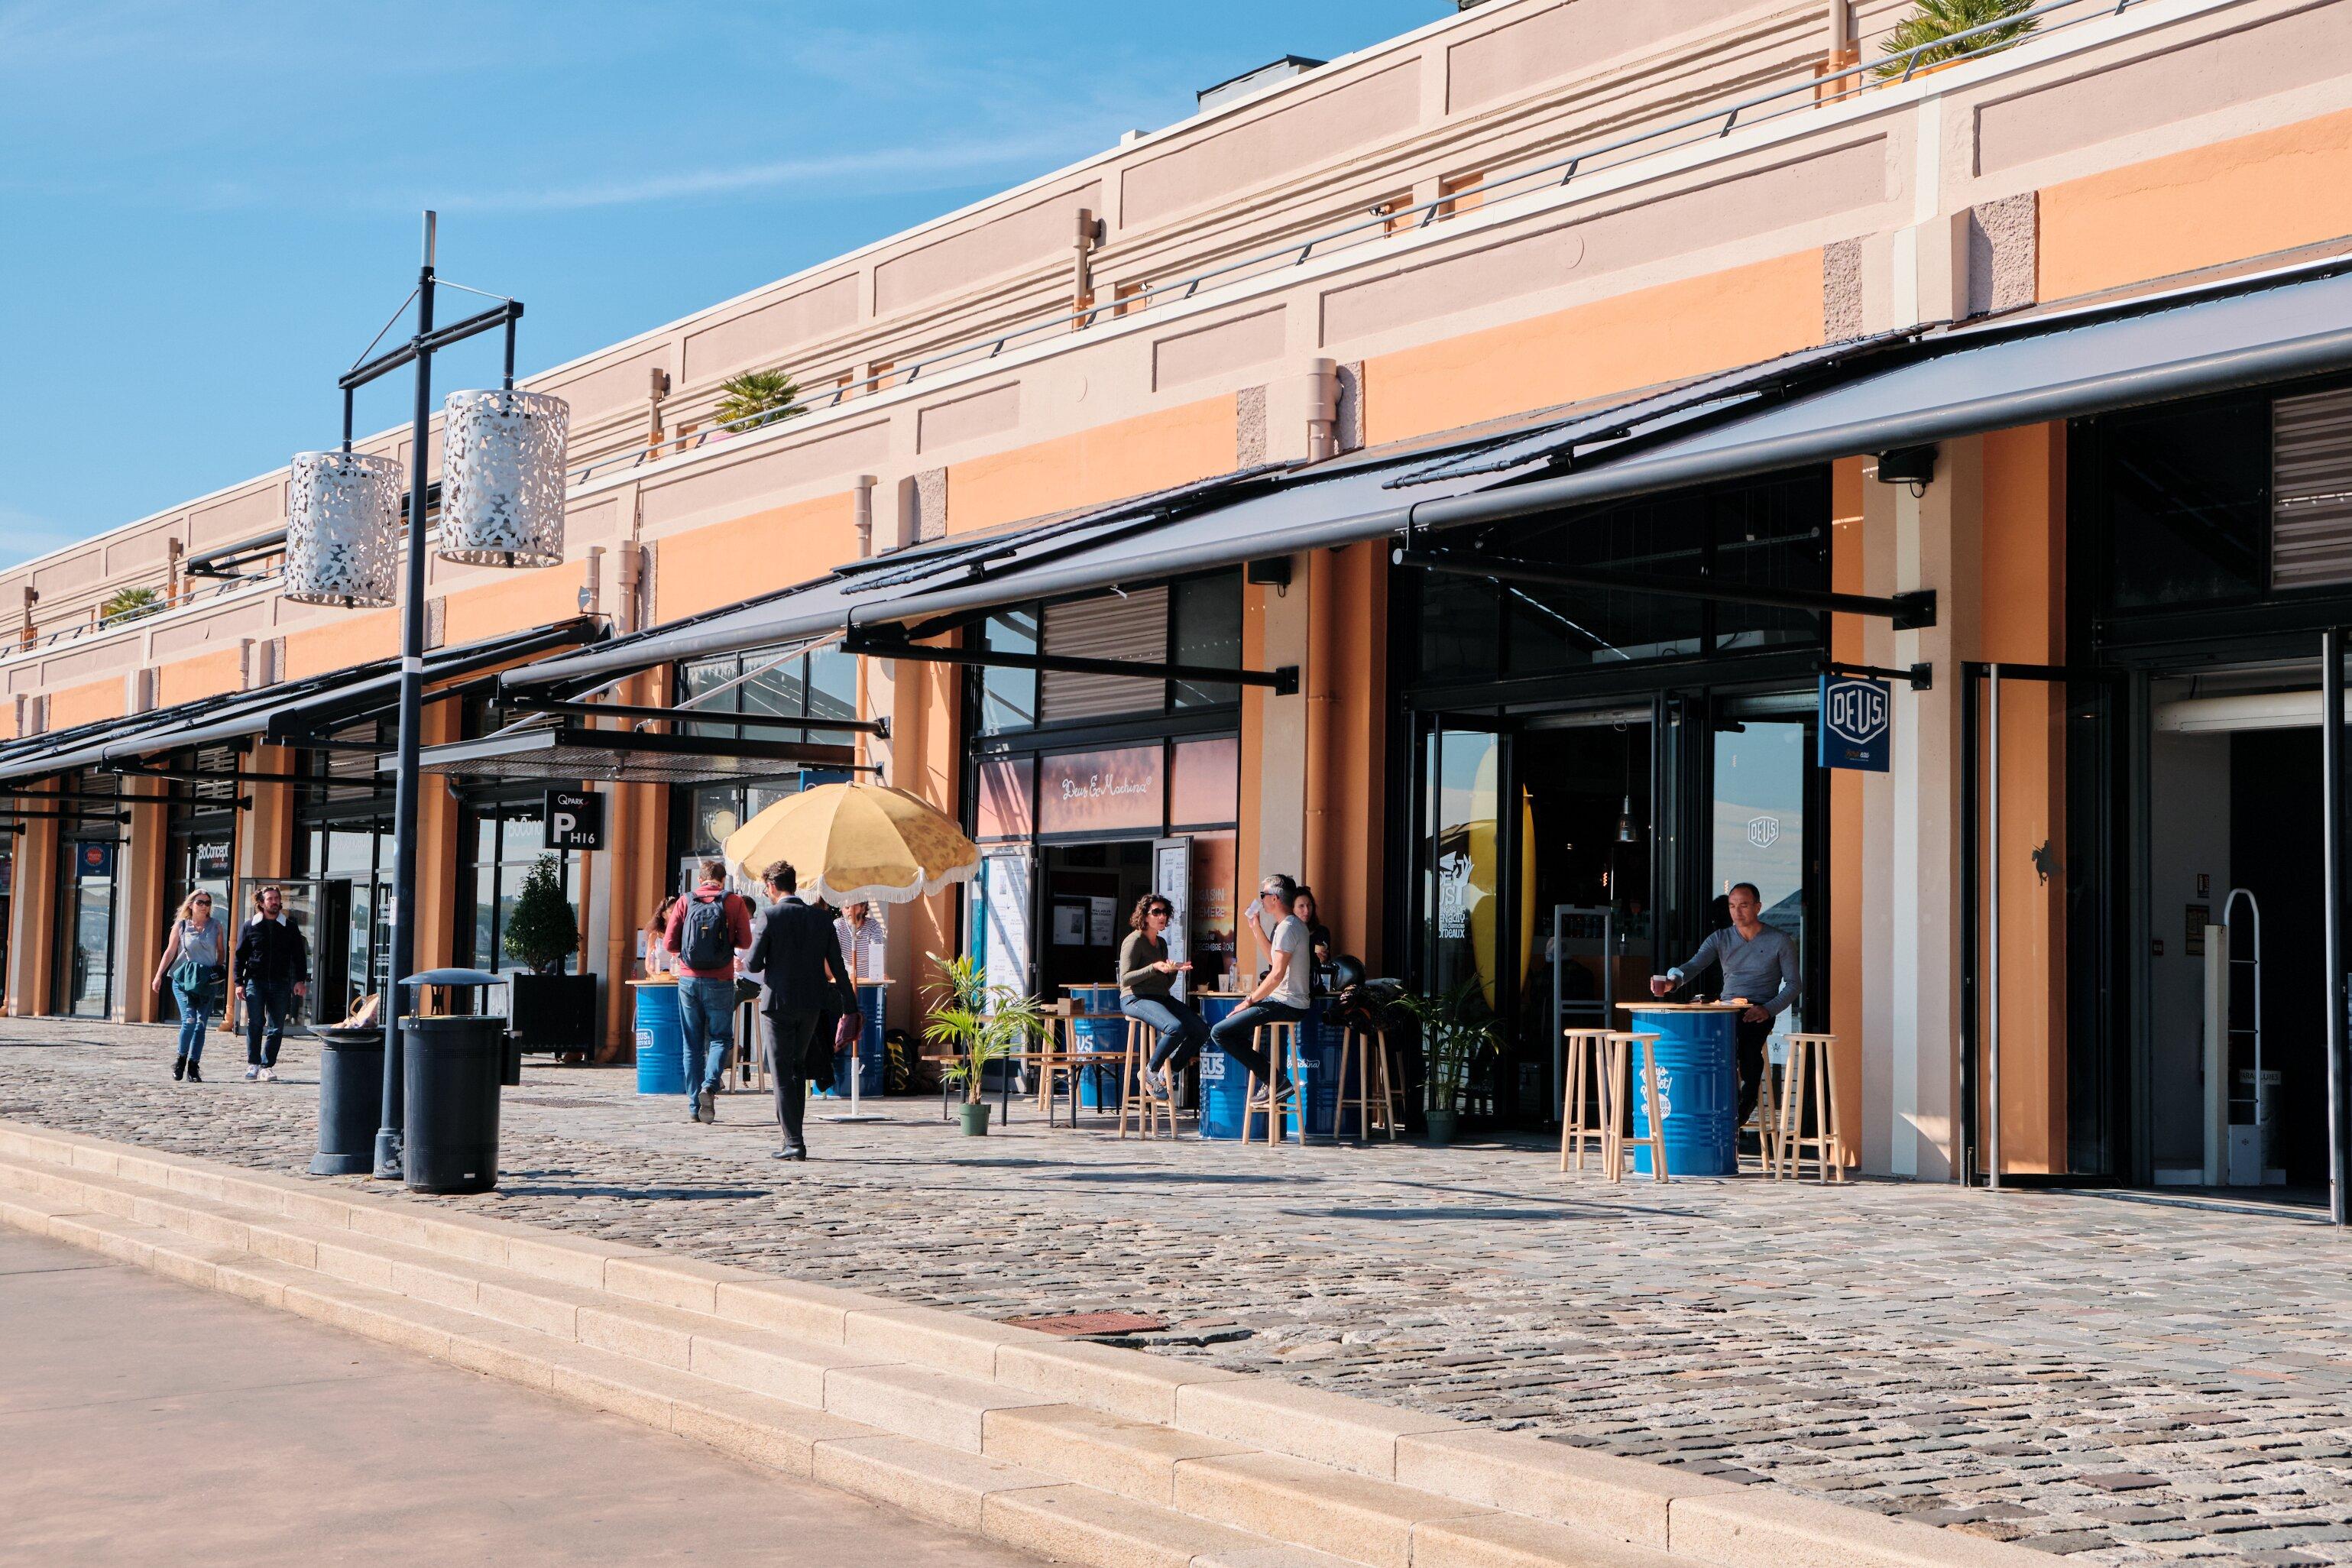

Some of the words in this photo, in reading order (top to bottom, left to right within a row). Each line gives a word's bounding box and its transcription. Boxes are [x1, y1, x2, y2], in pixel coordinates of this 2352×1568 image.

[1834, 688, 1882, 734] DEUS
[1062, 779, 1087, 800] Deus
[1101, 774, 1147, 795] Machina
[509, 817, 544, 837] BoConc
[553, 812, 576, 843] P
[571, 833, 594, 844] H16
[1751, 820, 1776, 843] DEUS
[198, 842, 230, 861] BoConcept
[1076, 1034, 1093, 1053] US
